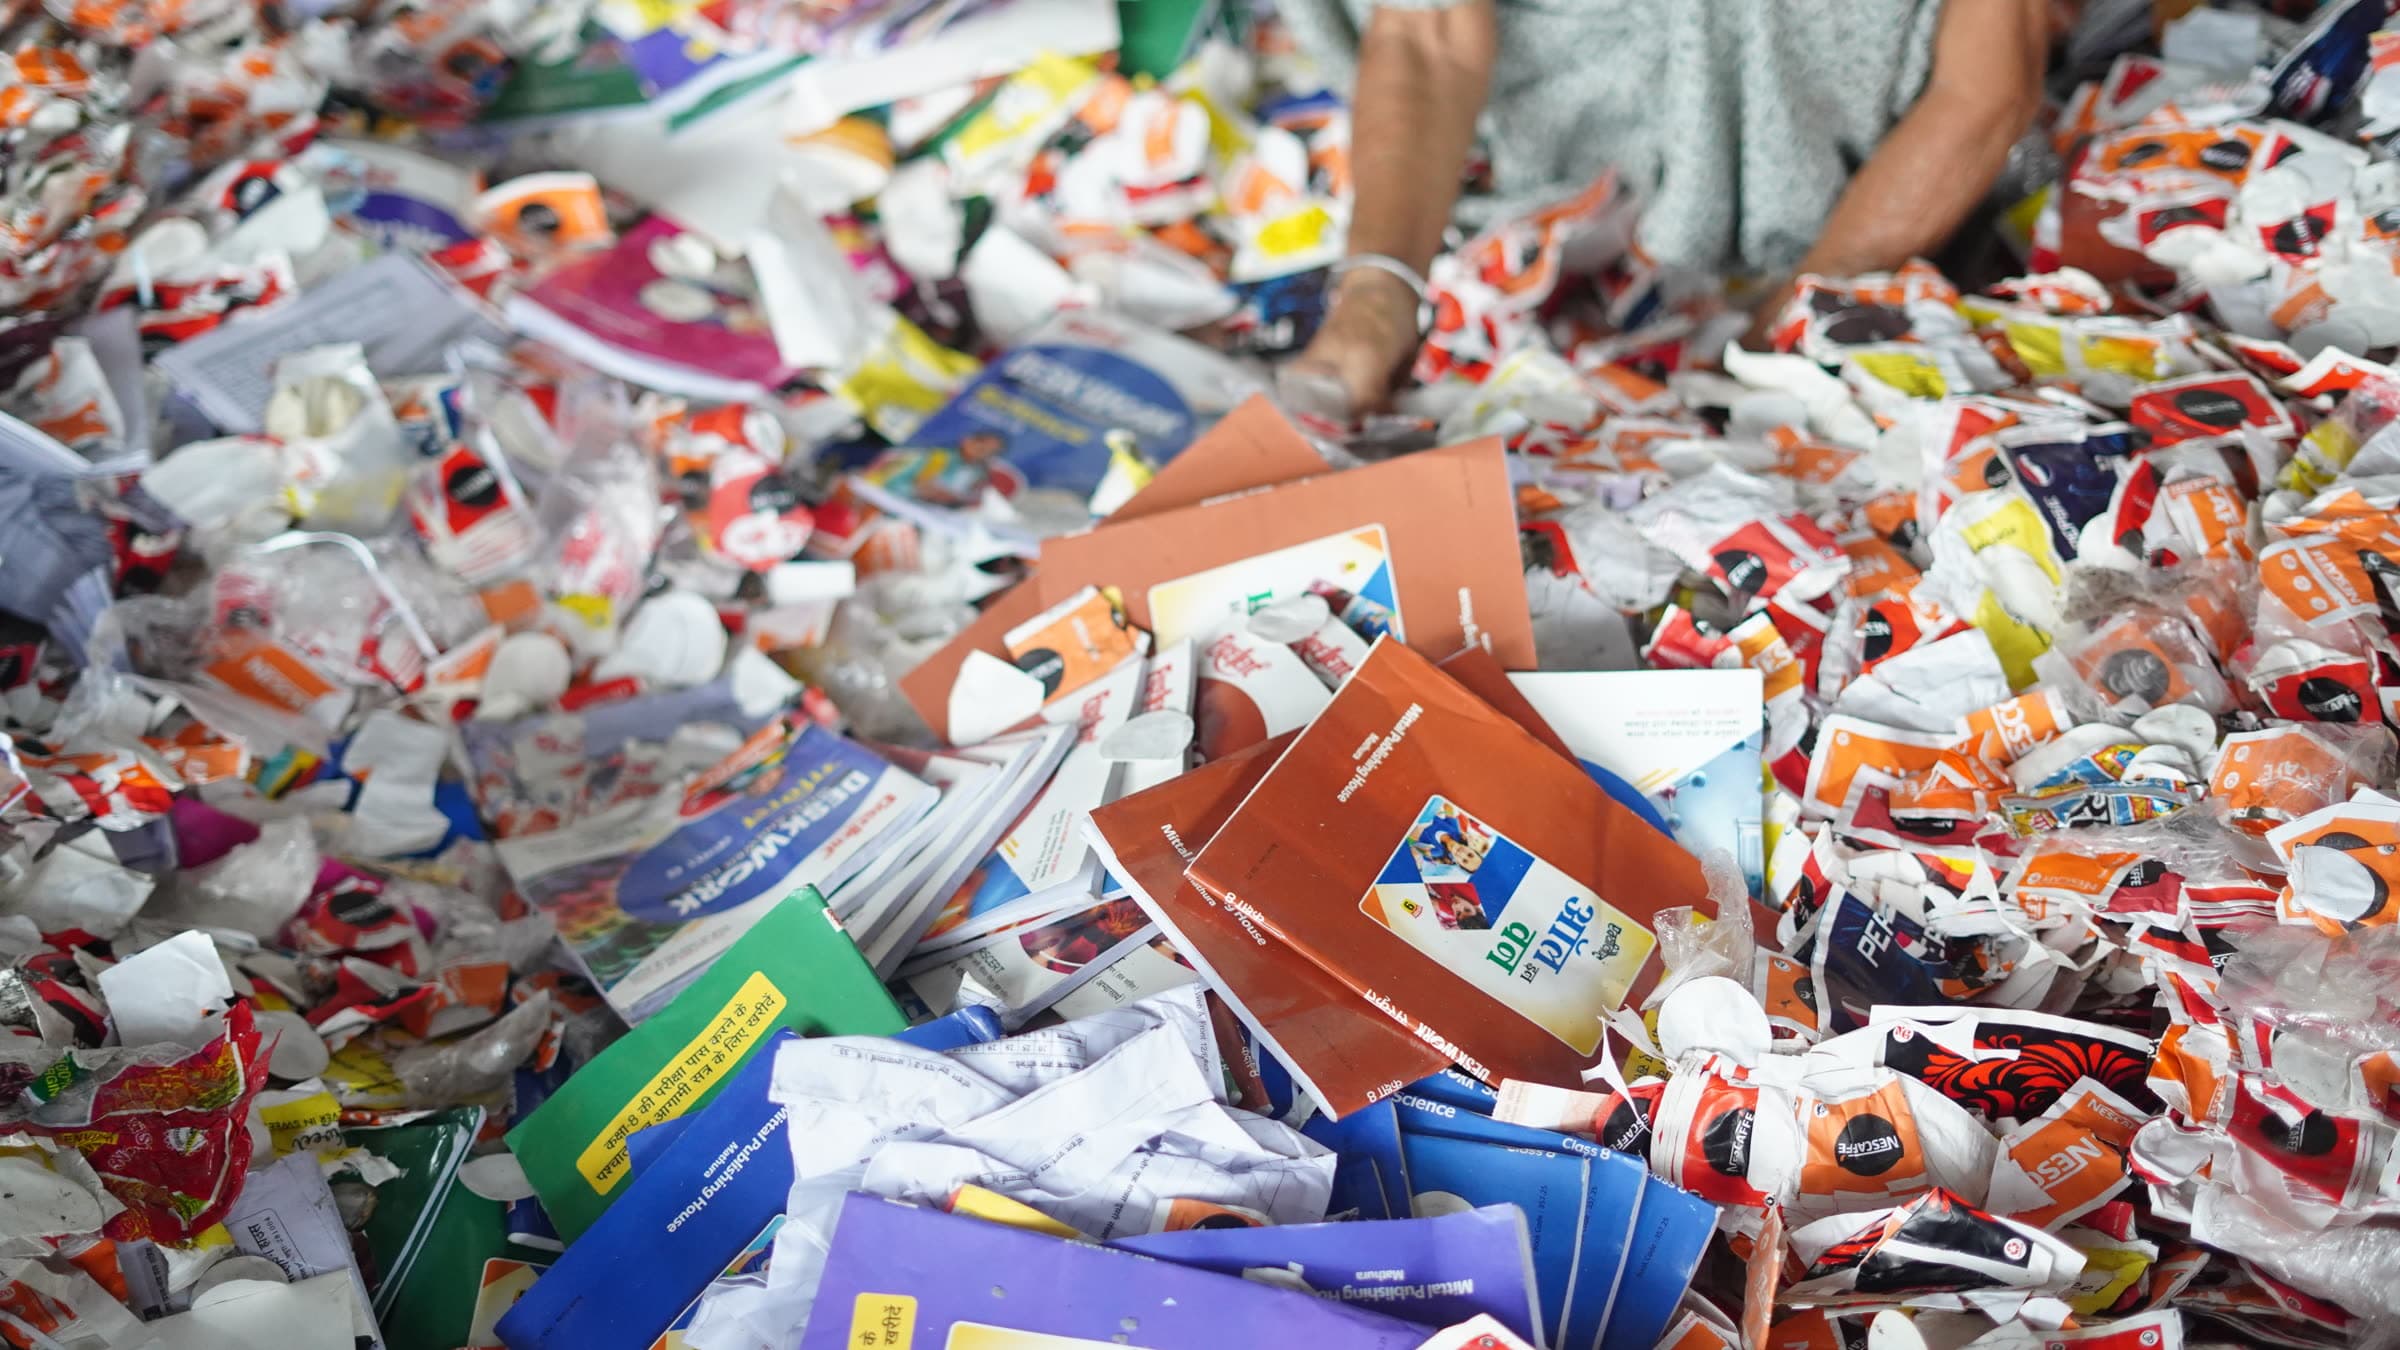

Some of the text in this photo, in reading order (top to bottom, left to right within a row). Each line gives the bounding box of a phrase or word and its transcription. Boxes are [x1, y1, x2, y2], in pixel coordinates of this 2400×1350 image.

[1337, 702, 1424, 803] Mittal Publishing House
[1224, 892, 1238, 905] 8
[1485, 920, 1538, 977] वन
[1533, 895, 1597, 976] ऑल
[637, 1095, 656, 1116] की
[653, 1067, 687, 1099] परीक्षा
[685, 1045, 711, 1069] पास
[709, 1016, 737, 1048] करने
[734, 1002, 748, 1019] के
[653, 1081, 693, 1123] आगामी
[691, 1065, 714, 1086] सत्र
[711, 1049, 727, 1067] के
[723, 1027, 750, 1053] लिए
[747, 992, 776, 1028] खरीदें
[1365, 1090, 1378, 1104] 8
[1391, 1091, 1457, 1118] Science
[703, 1141, 739, 1178] Mathura
[1562, 1137, 1612, 1161] Class 8
[702, 1138, 762, 1200] Publishing
[666, 1197, 708, 1233] House
[1342, 1283, 1426, 1302] Publishing
[1428, 1278, 1474, 1299] Mittal
